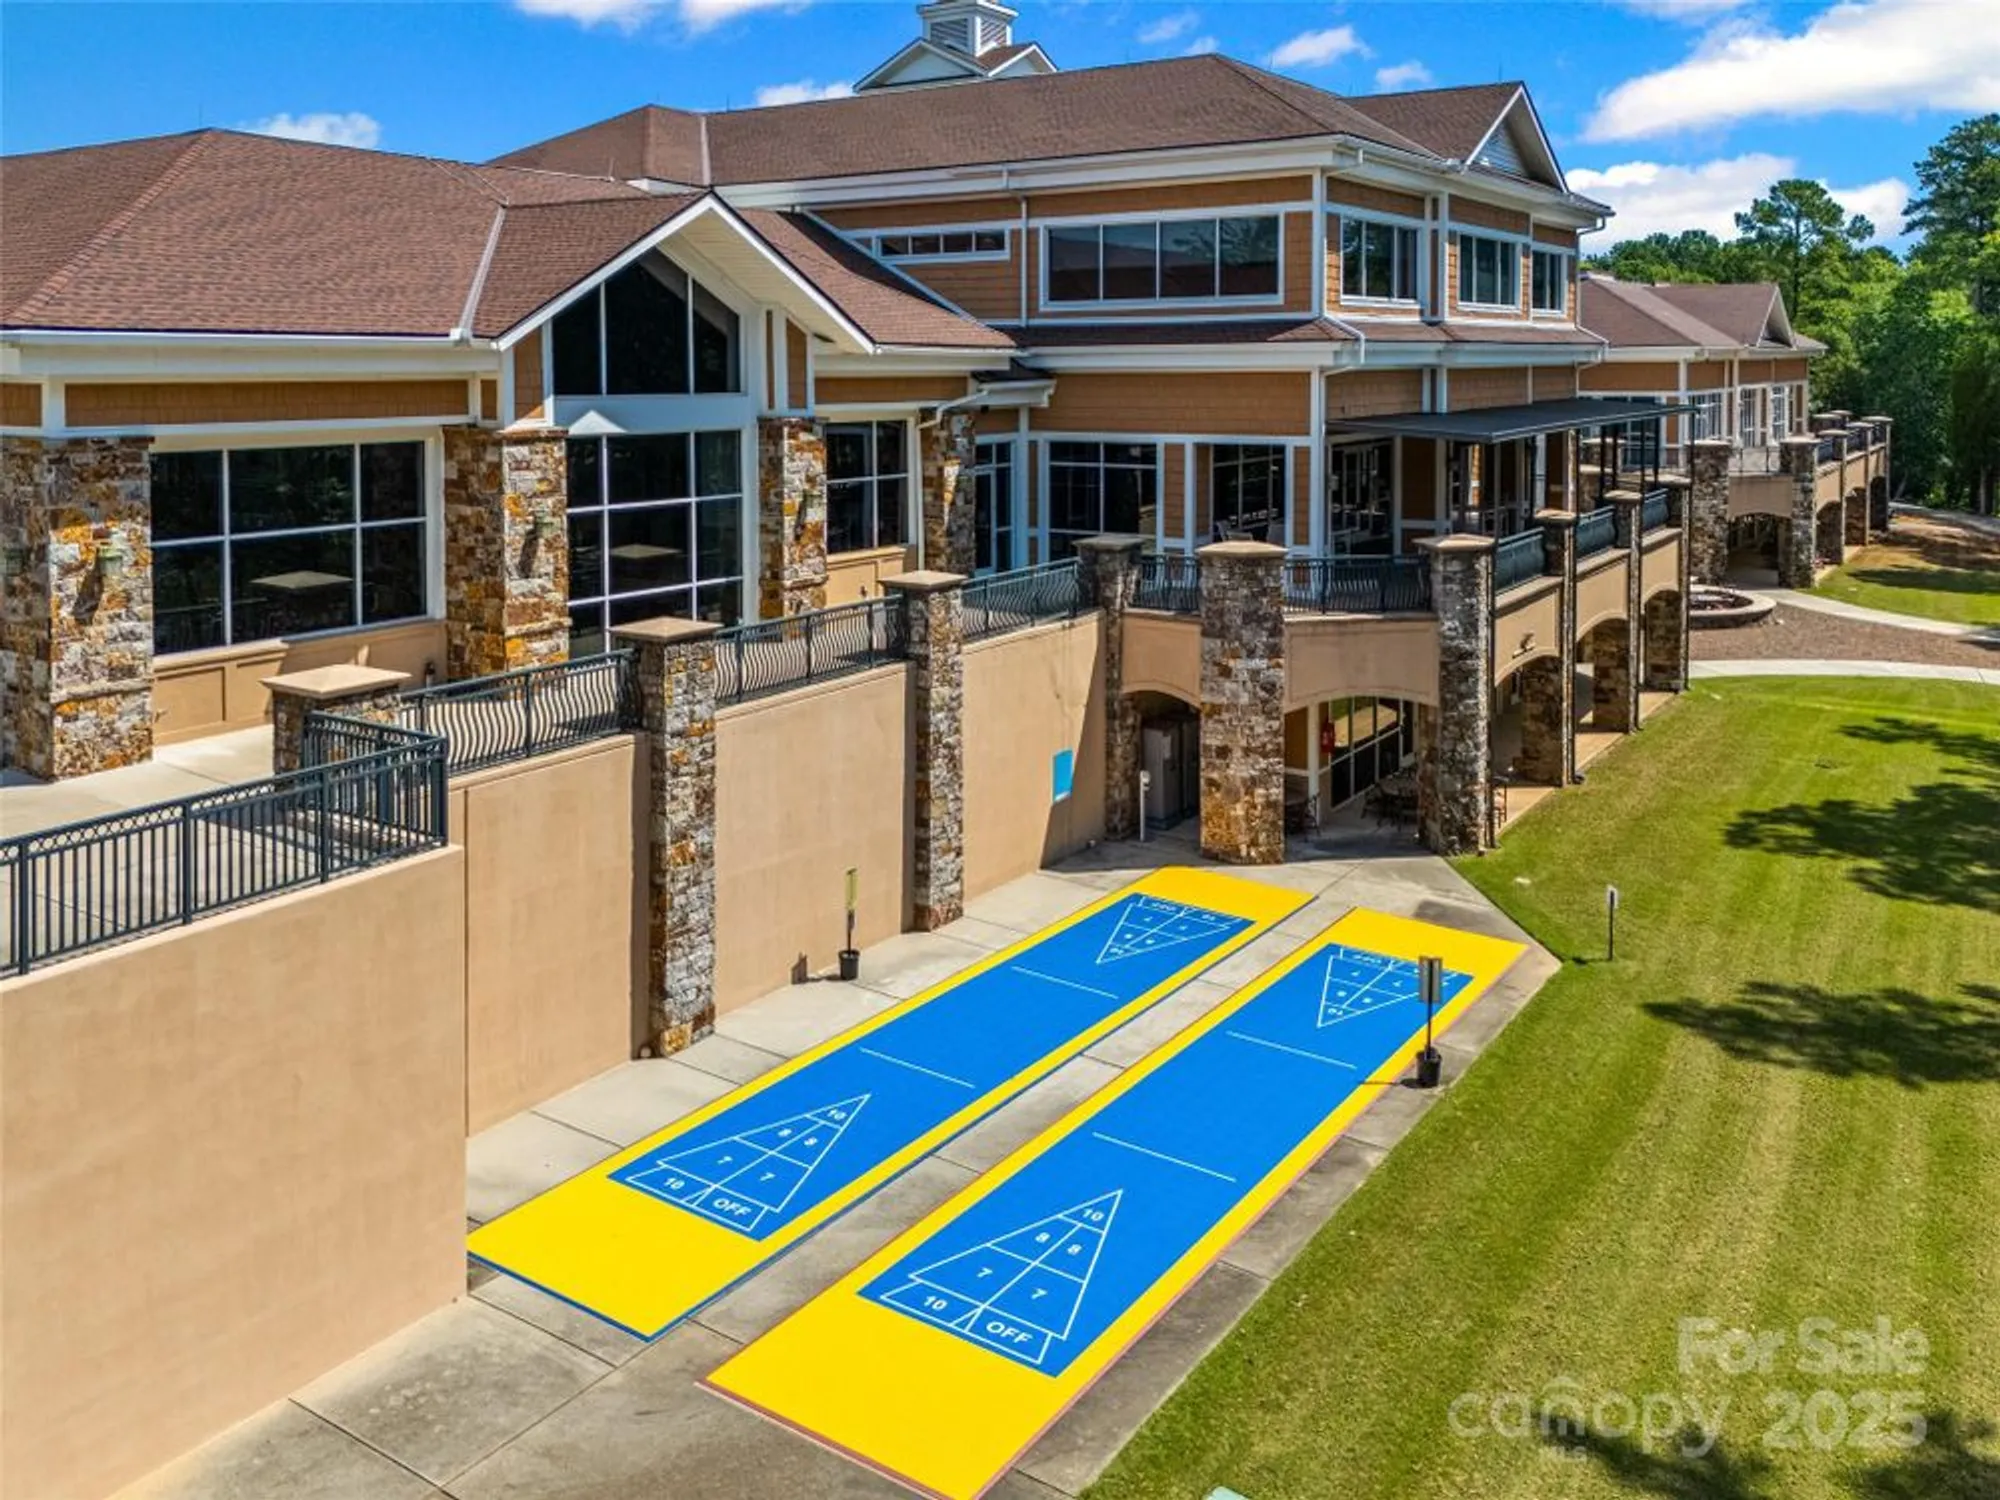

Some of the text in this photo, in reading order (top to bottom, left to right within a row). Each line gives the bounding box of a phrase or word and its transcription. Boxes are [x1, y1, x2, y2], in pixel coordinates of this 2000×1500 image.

[663, 1176, 686, 1191] 10
[759, 1172, 776, 1182] 7
[712, 1198, 751, 1218] OFF
[1081, 1208, 1105, 1222] 10
[1035, 1231, 1051, 1244] 8
[1066, 1243, 1083, 1256] 8
[976, 1267, 993, 1279] 7
[1031, 1288, 1048, 1300] 7
[923, 1295, 948, 1311] 10
[985, 1320, 1034, 1345] OFF
